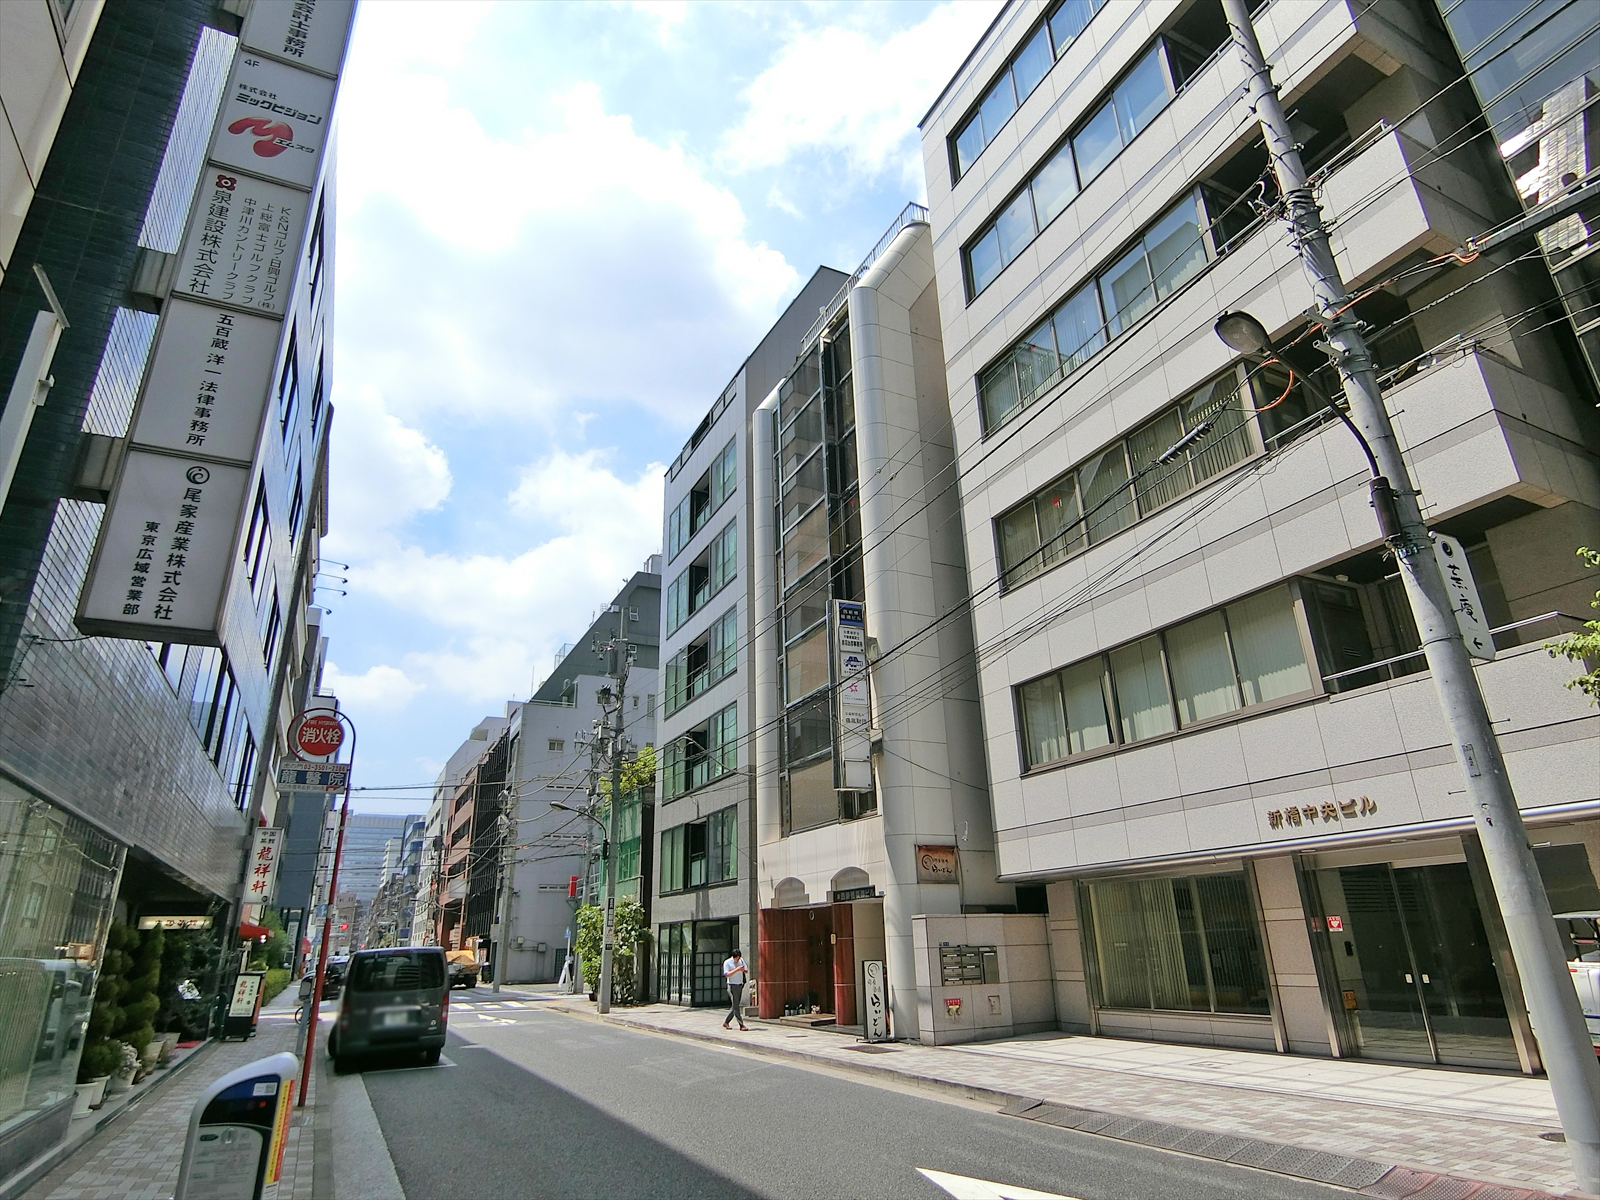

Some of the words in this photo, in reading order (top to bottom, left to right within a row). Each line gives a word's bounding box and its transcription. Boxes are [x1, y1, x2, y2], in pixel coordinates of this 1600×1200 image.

[244, 58, 260, 69] 4F
[235, 92, 323, 126] ミックビジョン
[238, 83, 278, 101] 株式会社
[189, 190, 233, 296] 泉建設株式会社
[222, 198, 257, 301] 中津川カントリークラブ
[242, 203, 275, 305] 上総富士ゴルフクラブ
[186, 313, 235, 447] 五百蔵洋一法律事務所
[122, 521, 161, 616] 東京広域営業部
[153, 487, 202, 620] 尾家産業株式会社
[301, 727, 342, 745] 消火栓
[1267, 796, 1378, 830] 新橋中央ビル
[251, 846, 274, 895] 龍祥軒
[870, 993, 883, 1038] らいどん
